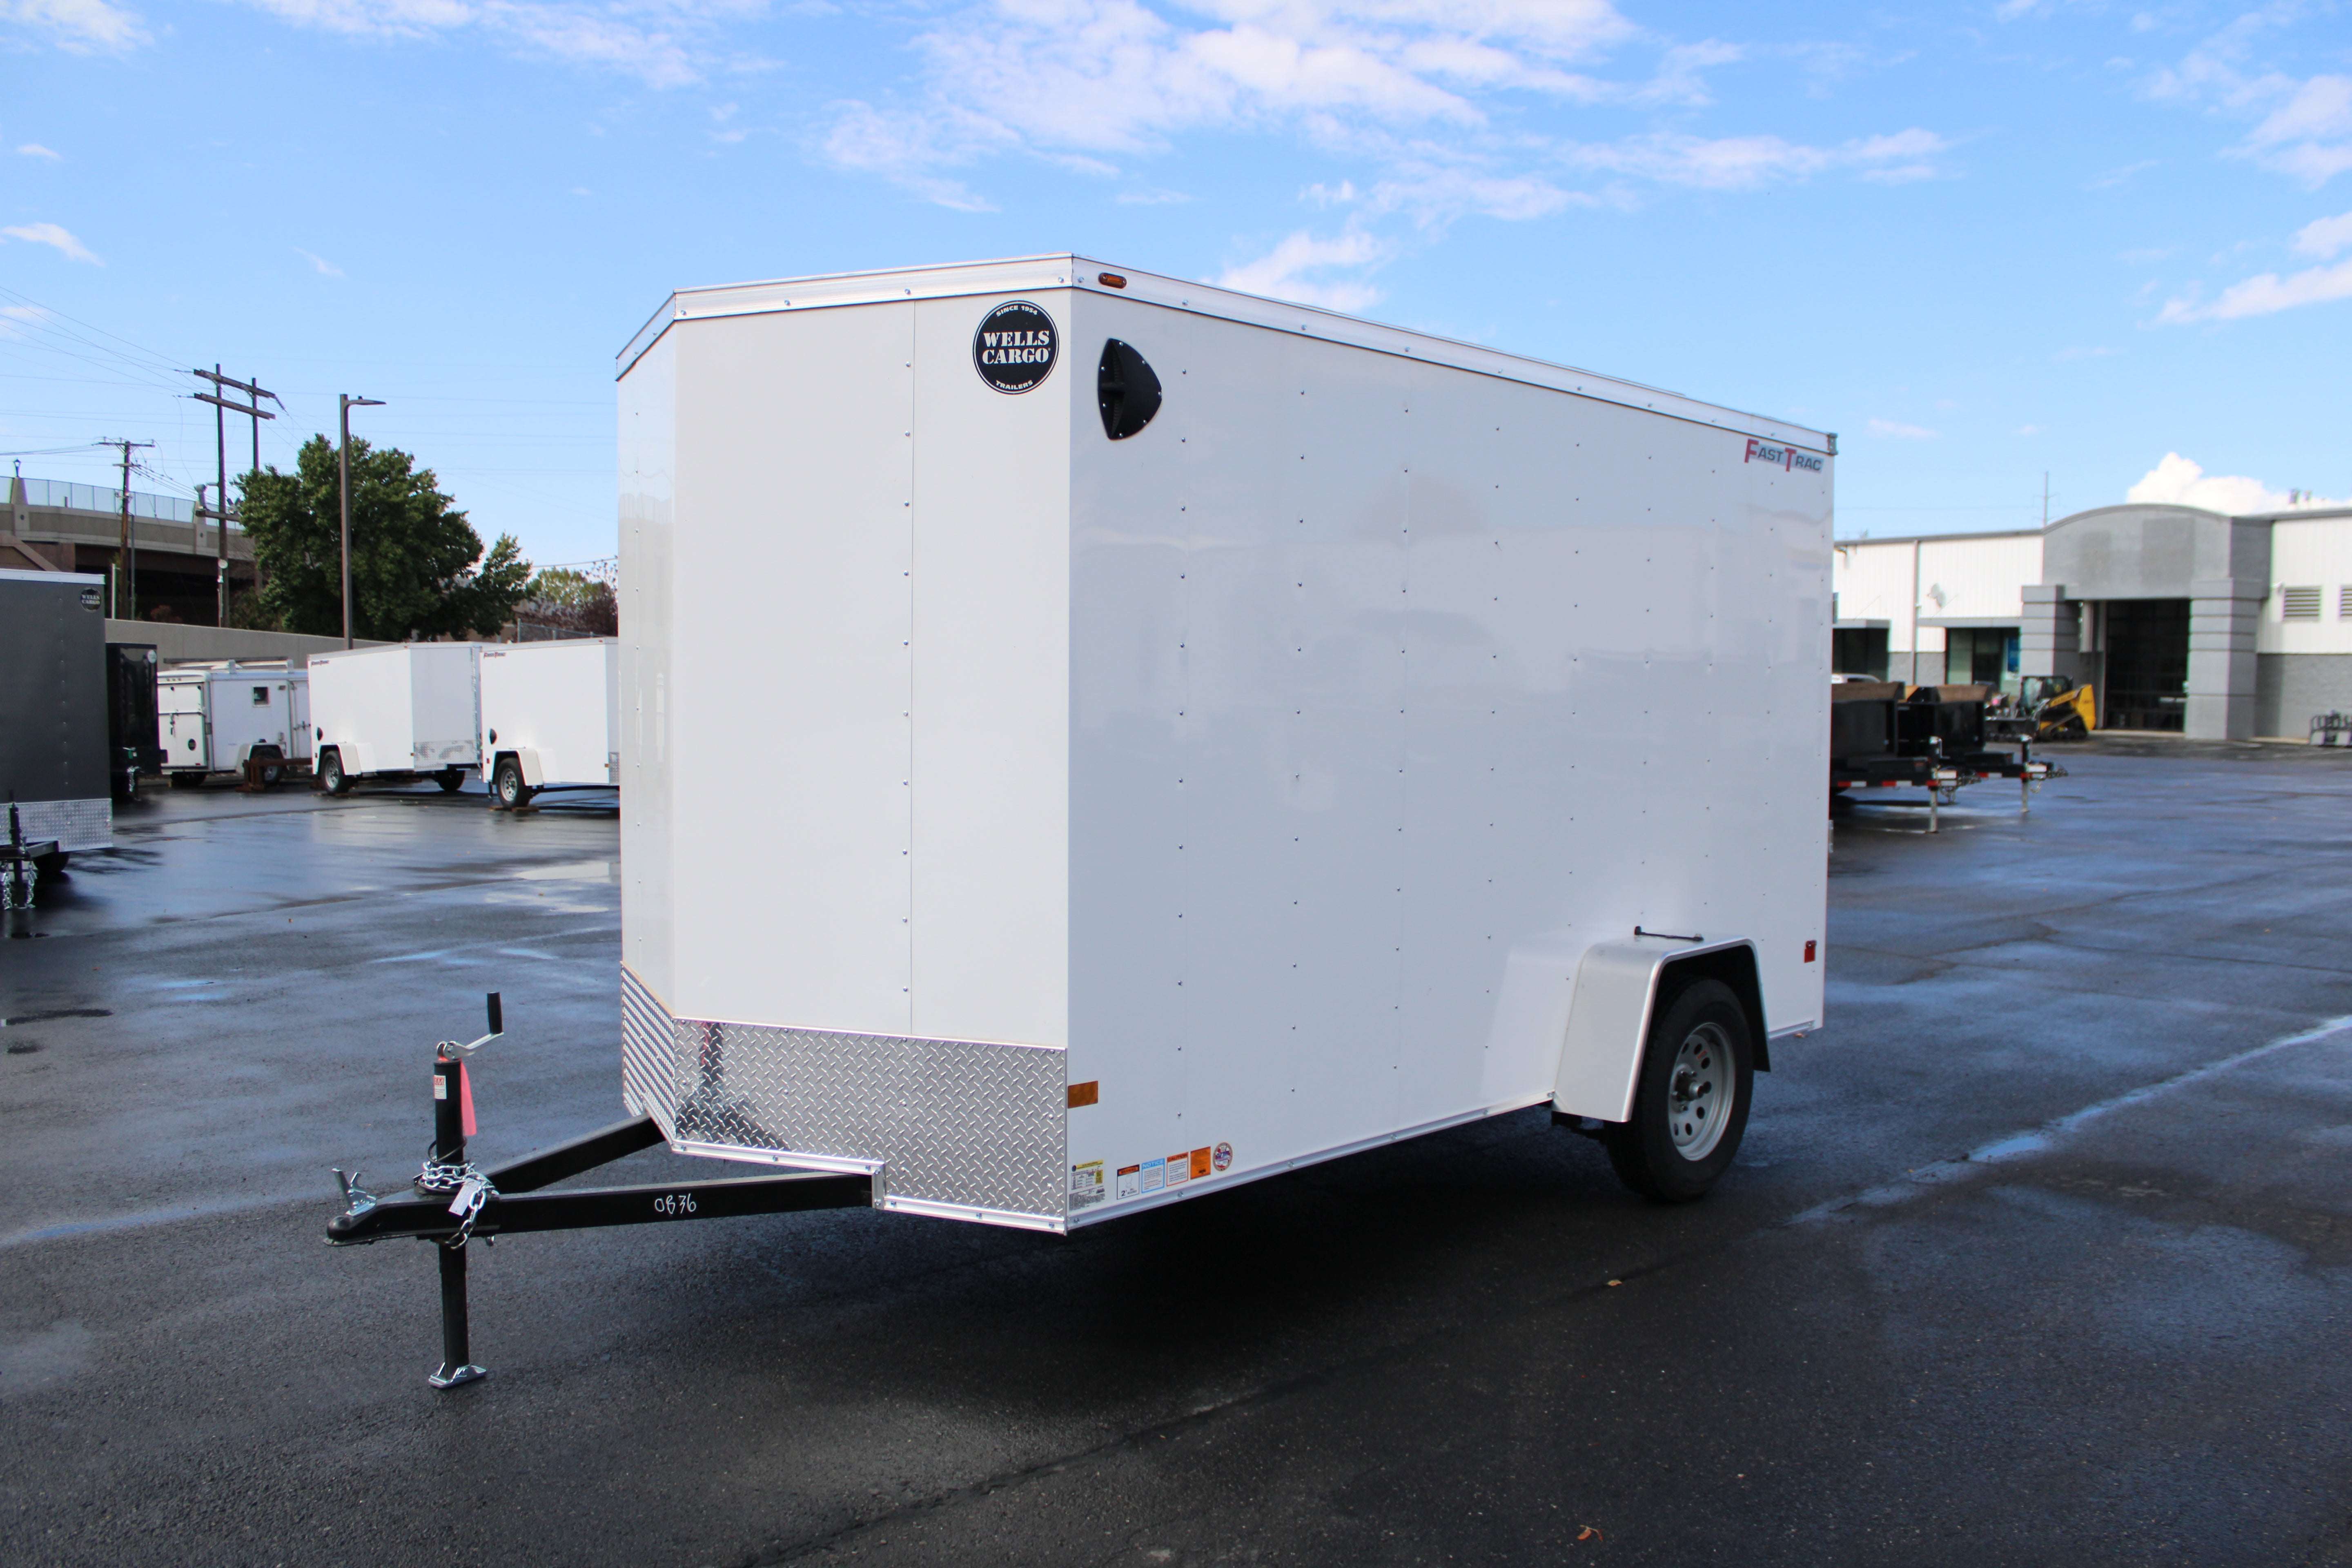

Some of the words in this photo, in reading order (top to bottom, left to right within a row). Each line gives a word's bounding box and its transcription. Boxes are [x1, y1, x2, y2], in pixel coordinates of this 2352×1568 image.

[996, 305, 1019, 317] SINCE
[1021, 306, 1038, 315] 1954
[983, 330, 1049, 347] WELLS
[982, 348, 1049, 364] CARGO
[996, 380, 1033, 390] TRAILERS
[1142, 1159, 1164, 1169] NOTICE
[655, 1193, 697, 1214] 0836
